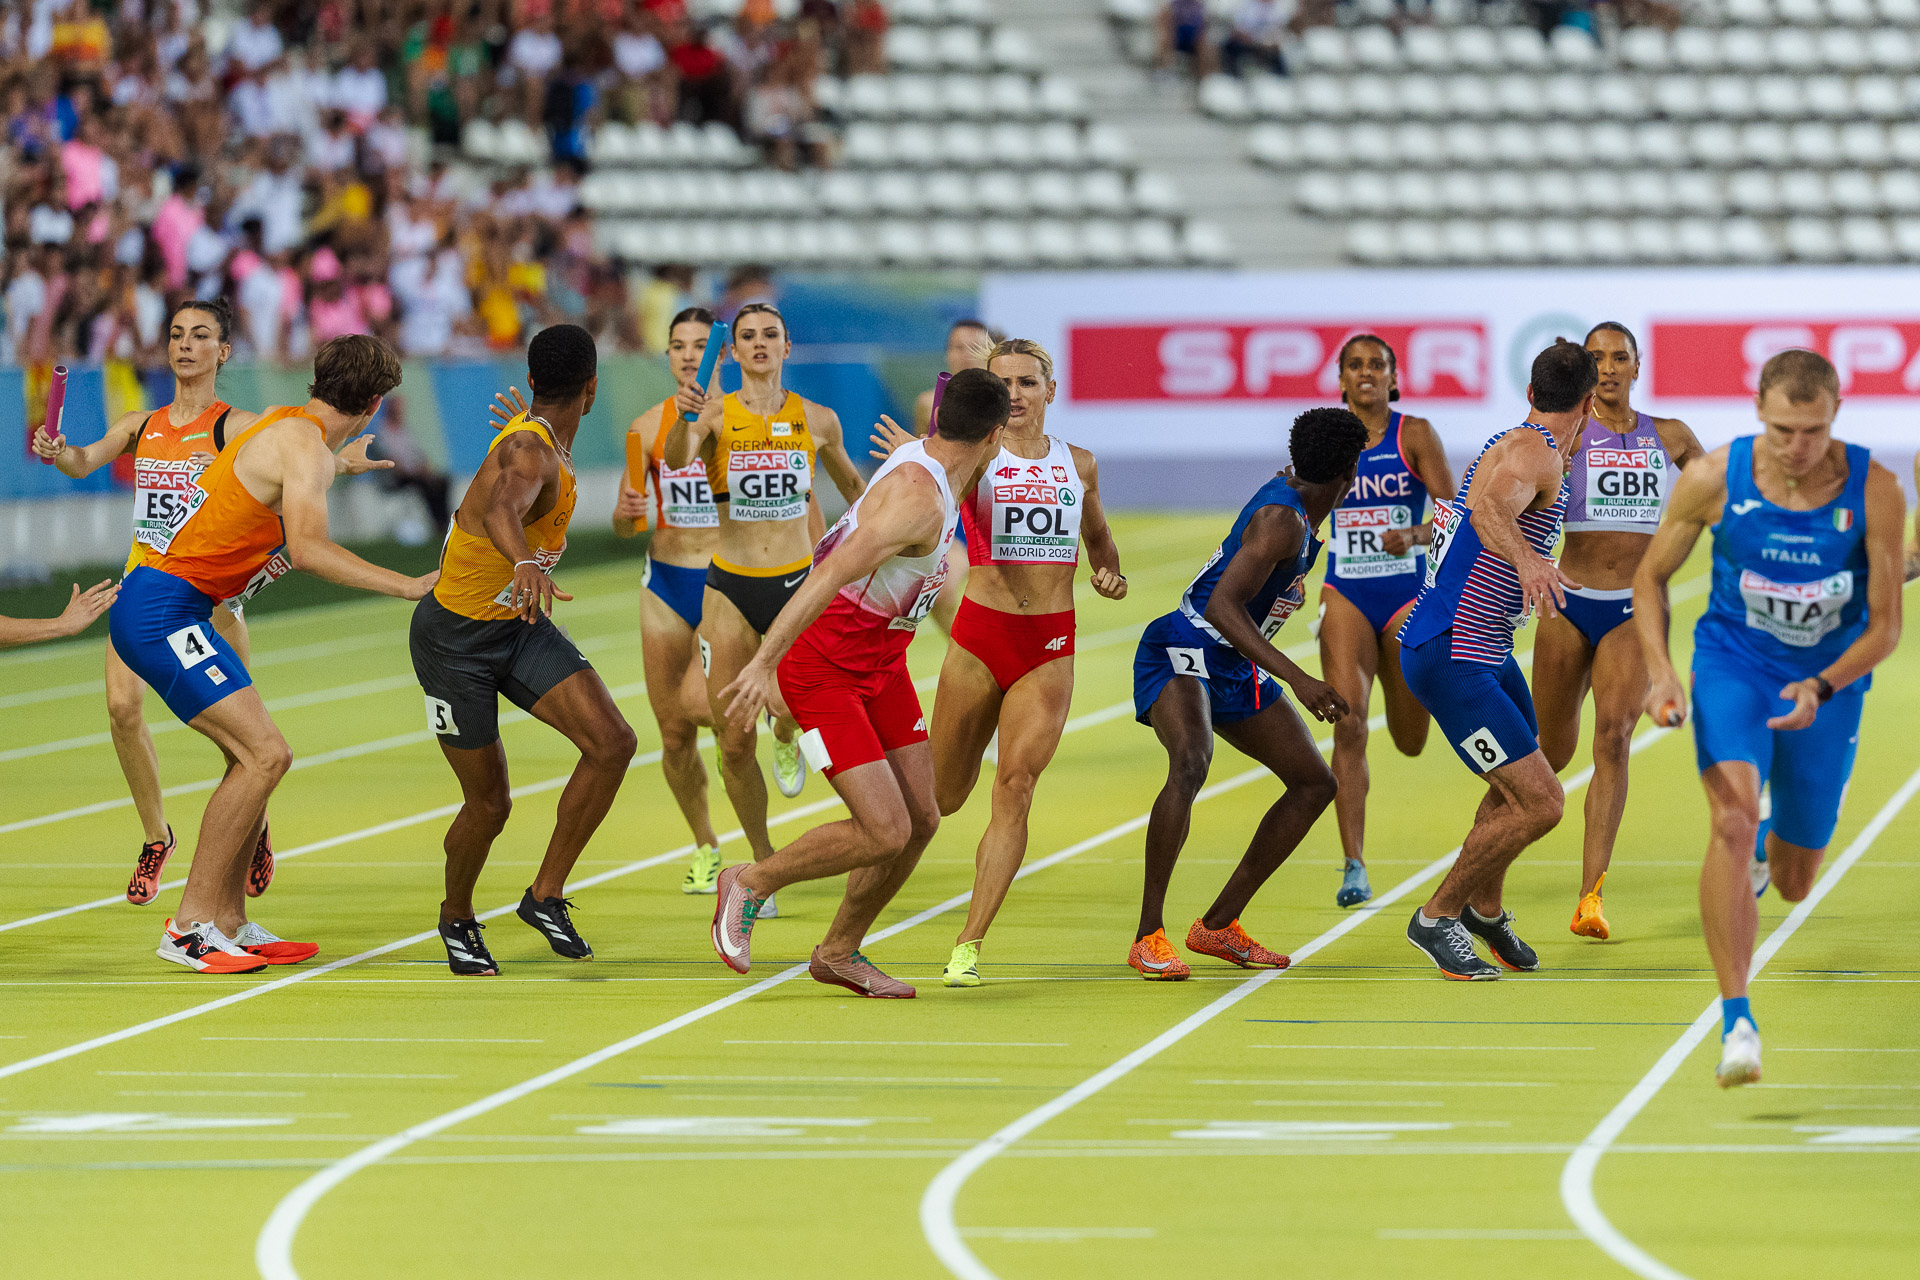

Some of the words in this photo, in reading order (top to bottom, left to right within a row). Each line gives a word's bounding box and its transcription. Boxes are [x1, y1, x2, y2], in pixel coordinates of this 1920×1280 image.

[731, 440, 802, 451] GERMANY
[730, 455, 787, 469] SPAR
[1590, 452, 1646, 466] SPAR
[138, 473, 187, 488] SPAR
[739, 473, 798, 499] GER
[1345, 472, 1412, 500] ANCE
[1598, 471, 1659, 497] GBR
[671, 481, 710, 504] NE
[996, 487, 1056, 502] SPAR
[146, 492, 182, 520] ES
[736, 509, 779, 518] MADRID
[781, 505, 802, 517] 2025
[1593, 508, 1638, 518] MADRID
[1004, 507, 1069, 535] POL
[1338, 510, 1388, 526] SPAR
[1347, 530, 1385, 554] FR
[1000, 547, 1046, 557] MADRID
[1048, 549, 1072, 559] 2025
[1761, 548, 1822, 566] ITALIA
[1343, 565, 1383, 575] MADRID
[1766, 597, 1822, 623] ITA
[185, 632, 205, 656] 4
[1179, 653, 1200, 673] 2
[436, 705, 446, 730] 5
[1474, 738, 1496, 763] 8
